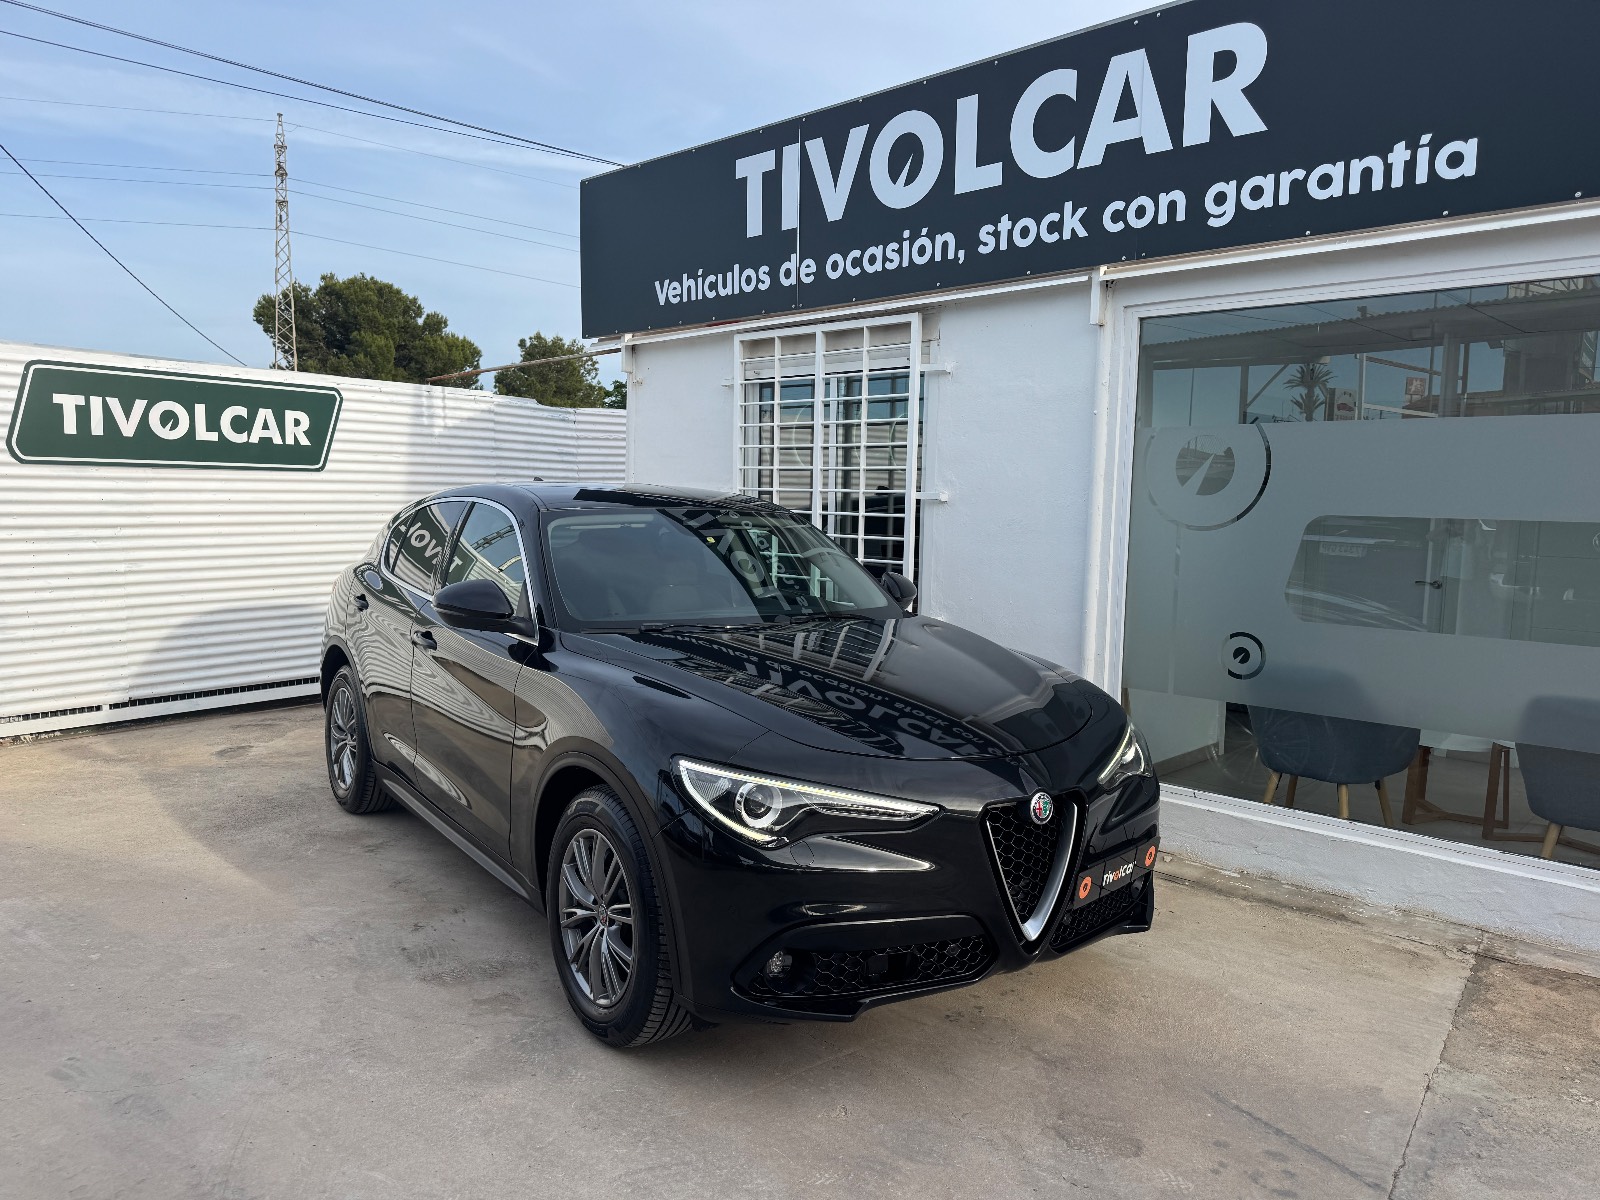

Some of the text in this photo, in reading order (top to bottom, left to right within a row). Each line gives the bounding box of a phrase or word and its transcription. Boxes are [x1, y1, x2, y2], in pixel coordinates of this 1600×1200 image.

[735, 21, 1269, 239] TIVOLCAR
[654, 133, 1480, 306] Vehículos de ocasión, stock con garantía
[52, 392, 312, 446] TIVOLCAR
